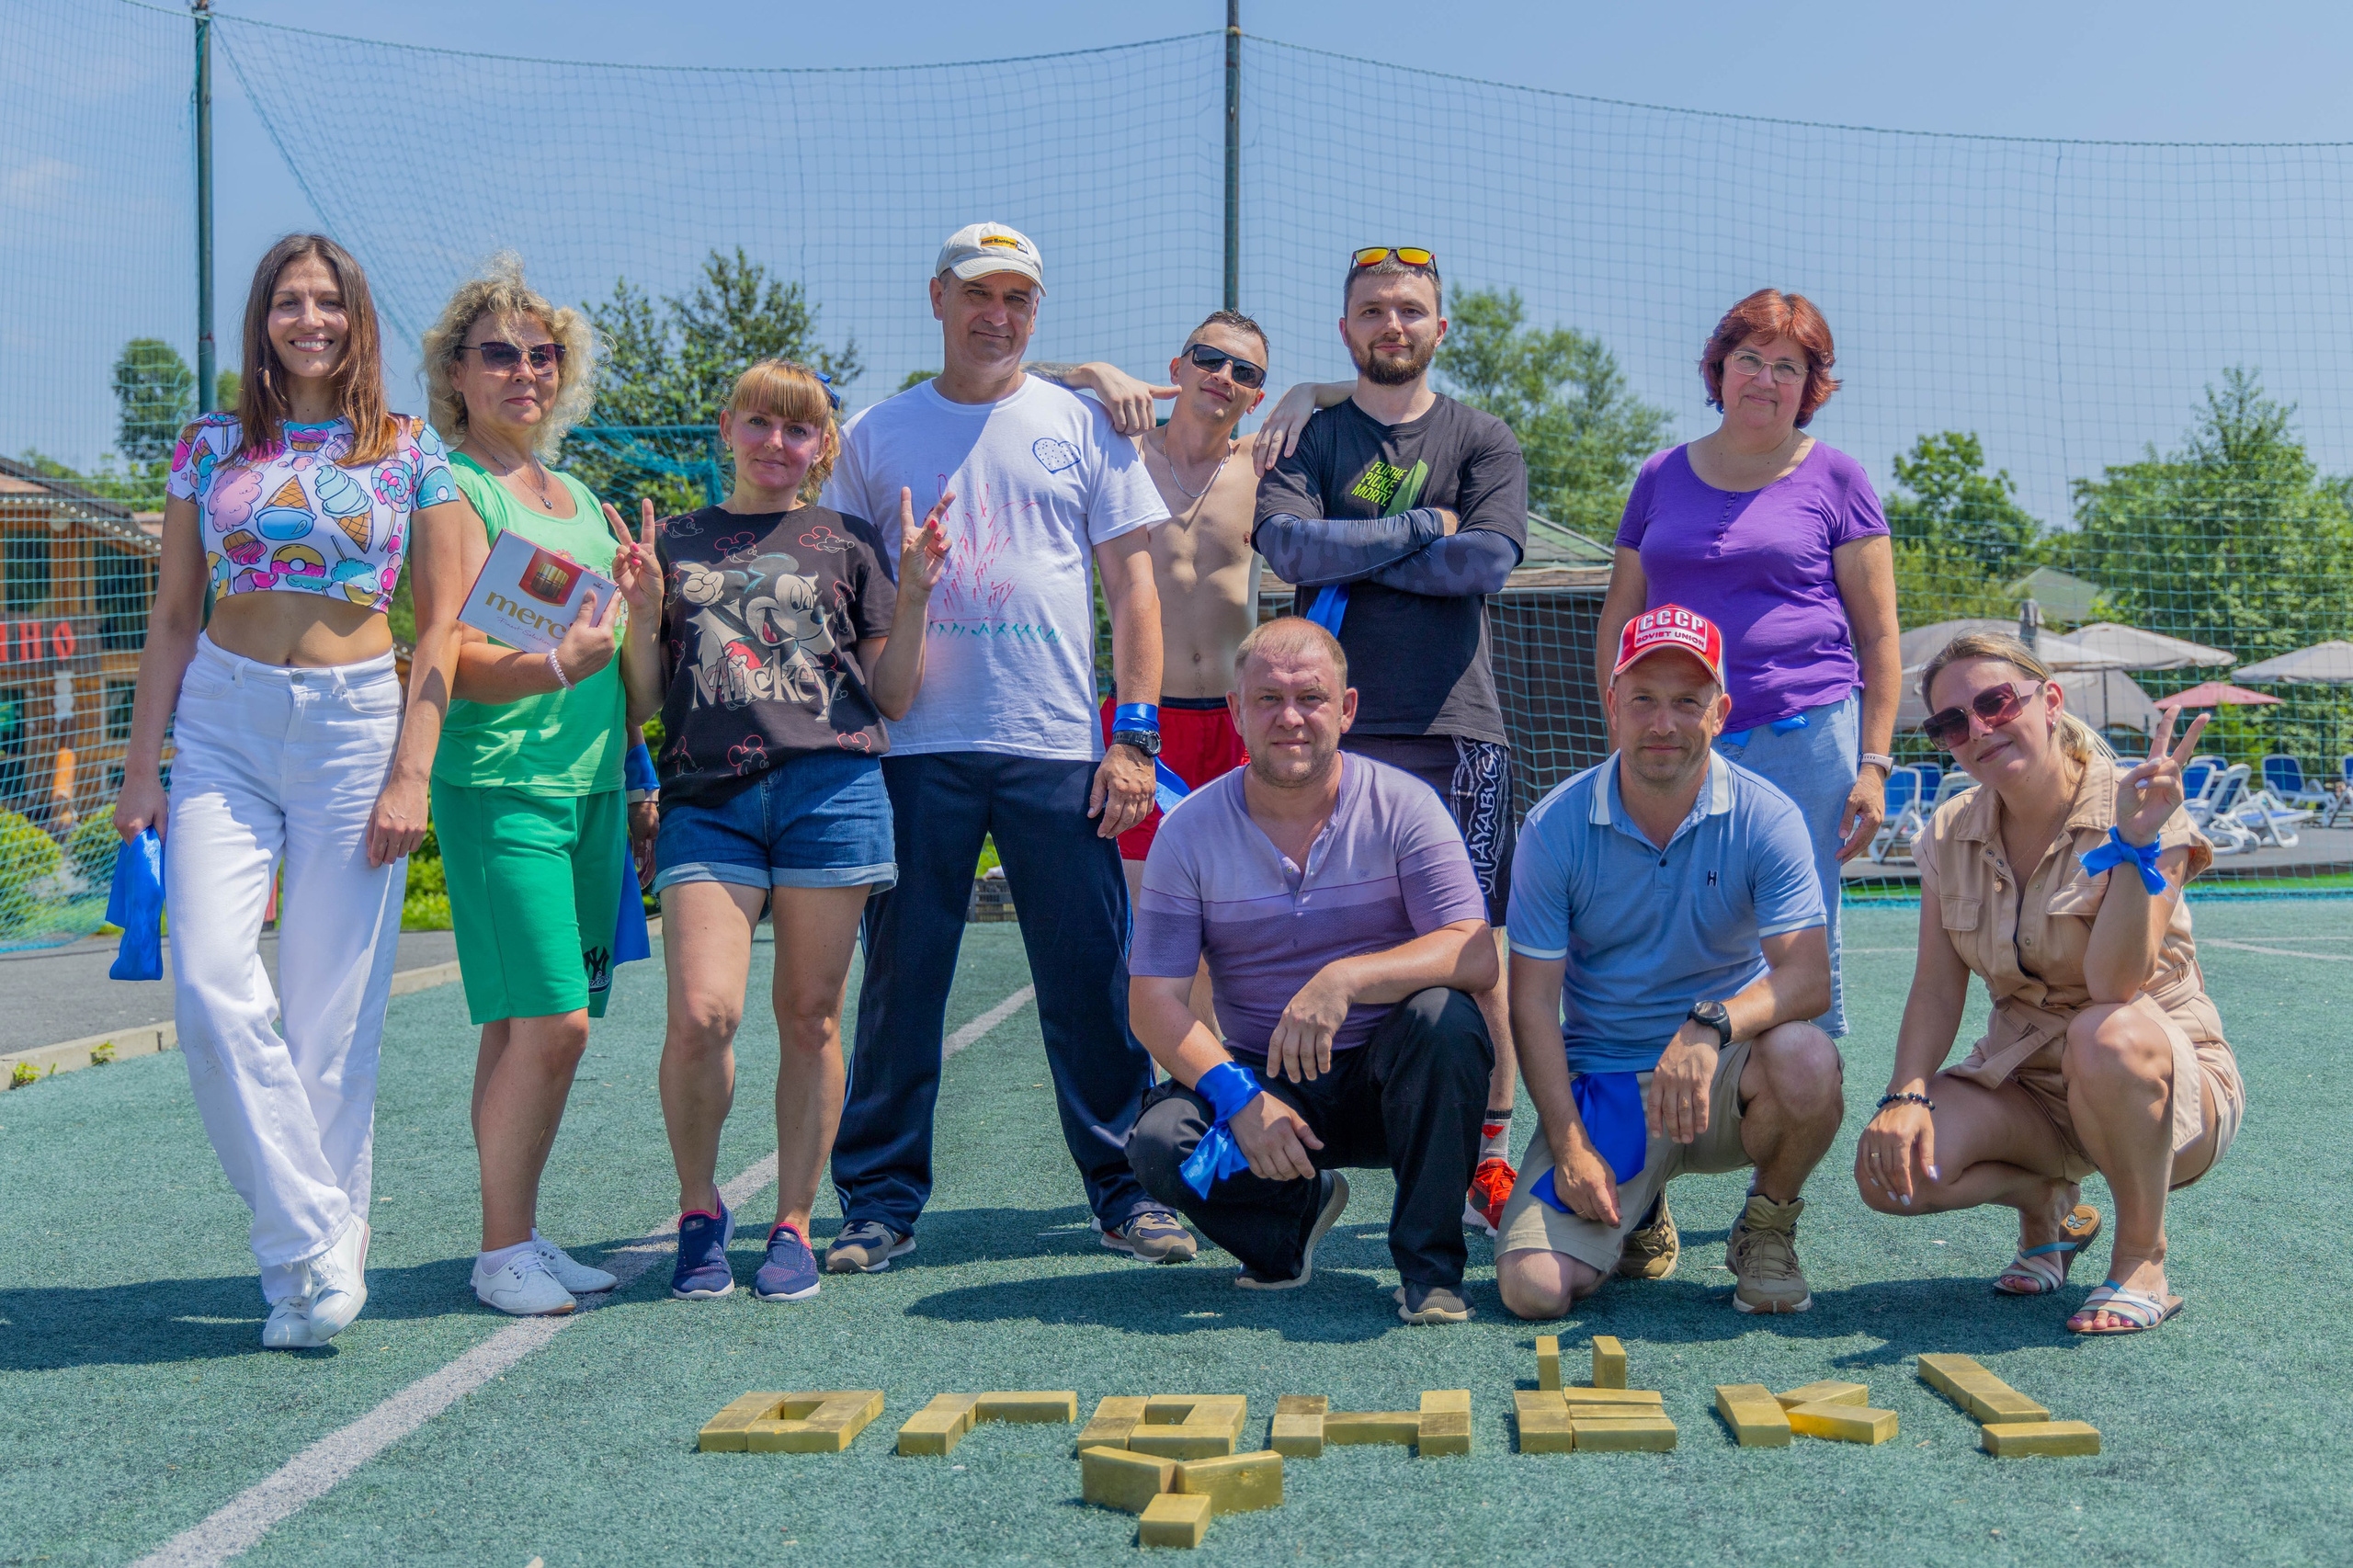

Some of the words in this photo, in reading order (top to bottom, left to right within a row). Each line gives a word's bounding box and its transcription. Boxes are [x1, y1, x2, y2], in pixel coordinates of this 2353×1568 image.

[485, 591, 572, 640] merc
[1636, 631, 1672, 644] SOVIET
[1675, 631, 1705, 648] UNION
